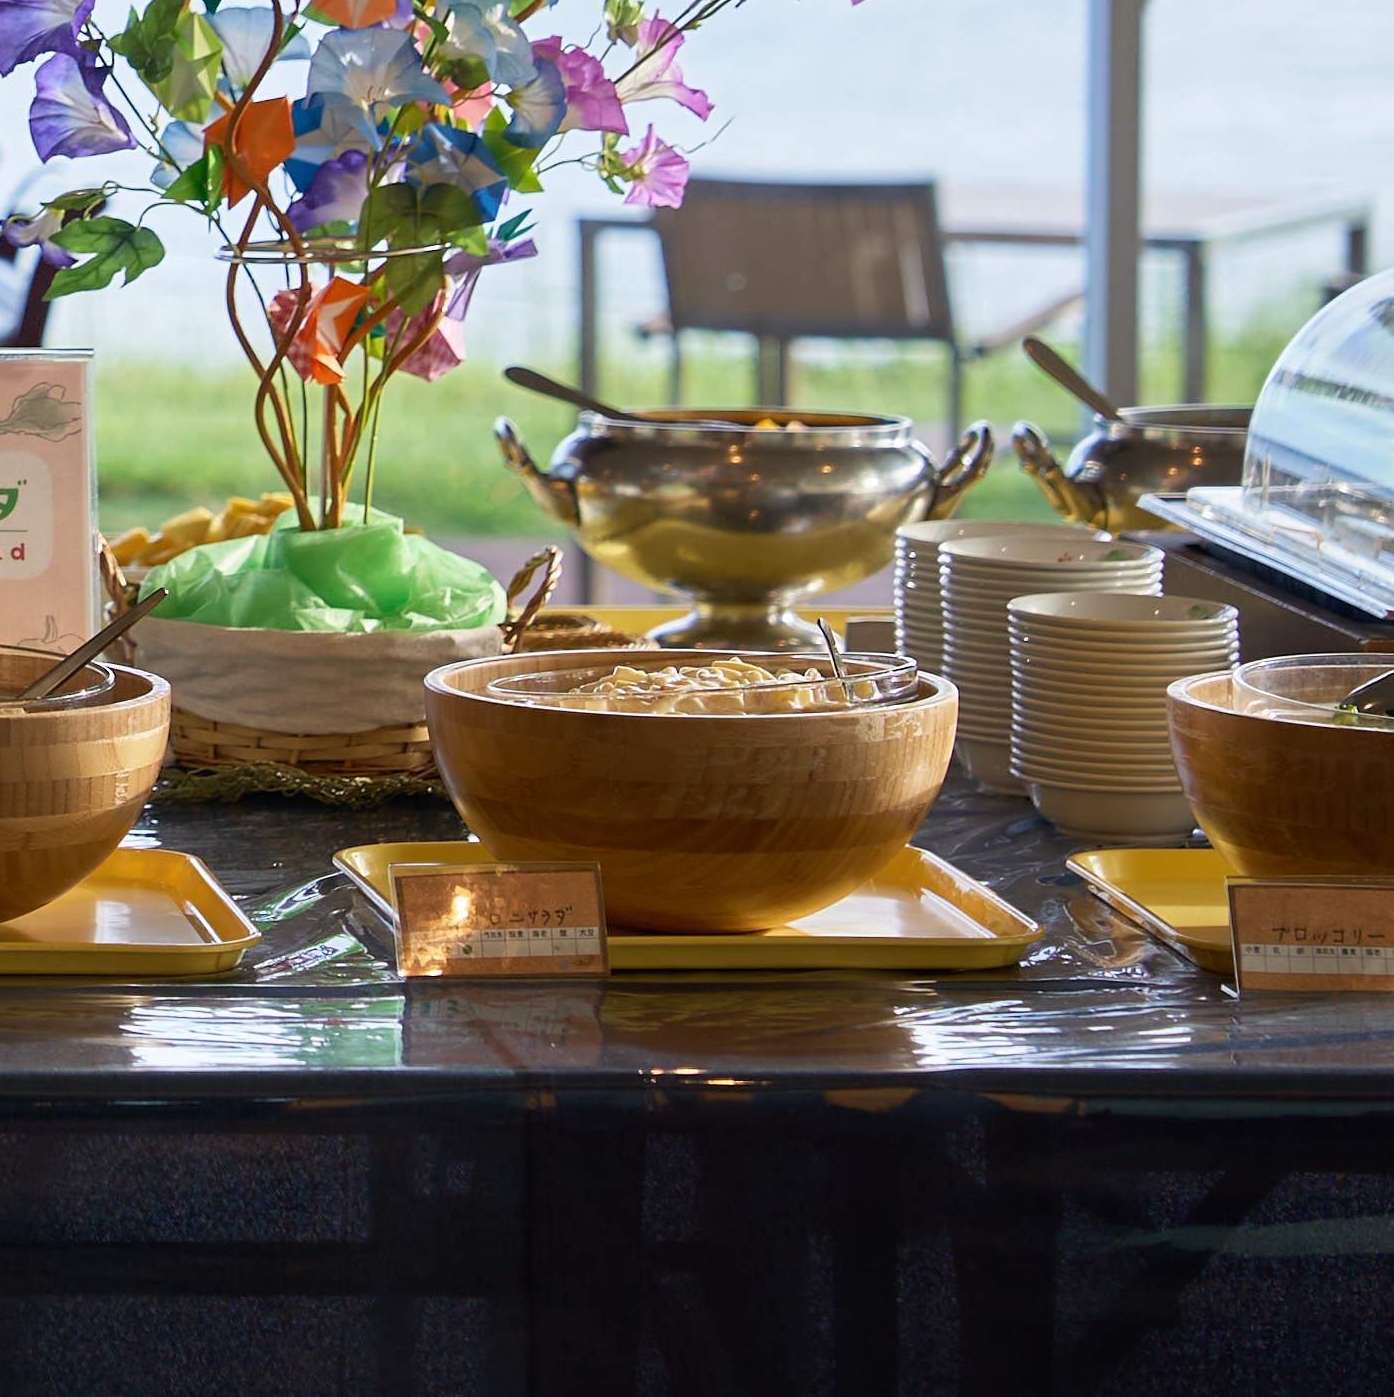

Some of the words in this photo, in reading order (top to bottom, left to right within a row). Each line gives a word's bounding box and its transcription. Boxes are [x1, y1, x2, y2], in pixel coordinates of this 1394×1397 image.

[1272, 925, 1385, 945] ブロッコリー
